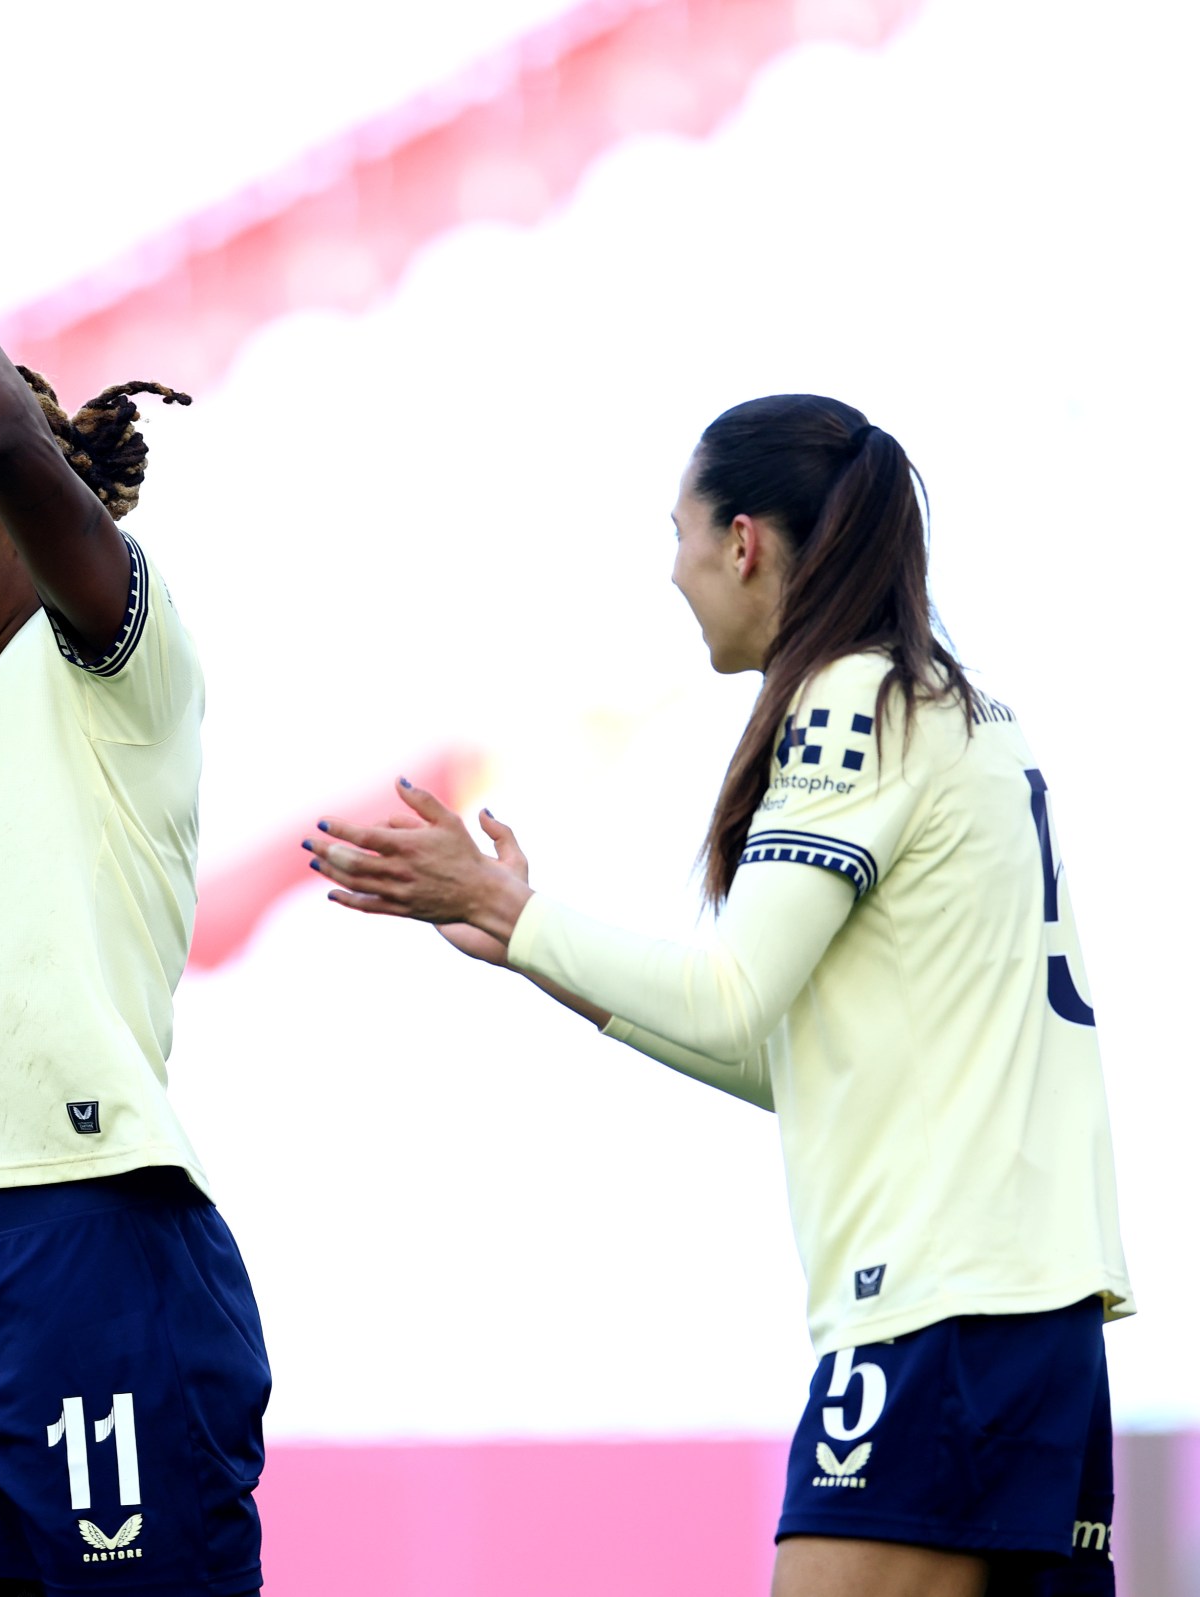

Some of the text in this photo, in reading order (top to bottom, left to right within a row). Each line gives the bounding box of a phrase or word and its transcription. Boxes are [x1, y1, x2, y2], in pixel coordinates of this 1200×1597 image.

[822, 1346, 887, 1441] 5
[46, 1392, 142, 1511] 11
[82, 1548, 143, 1563] CASTORE
